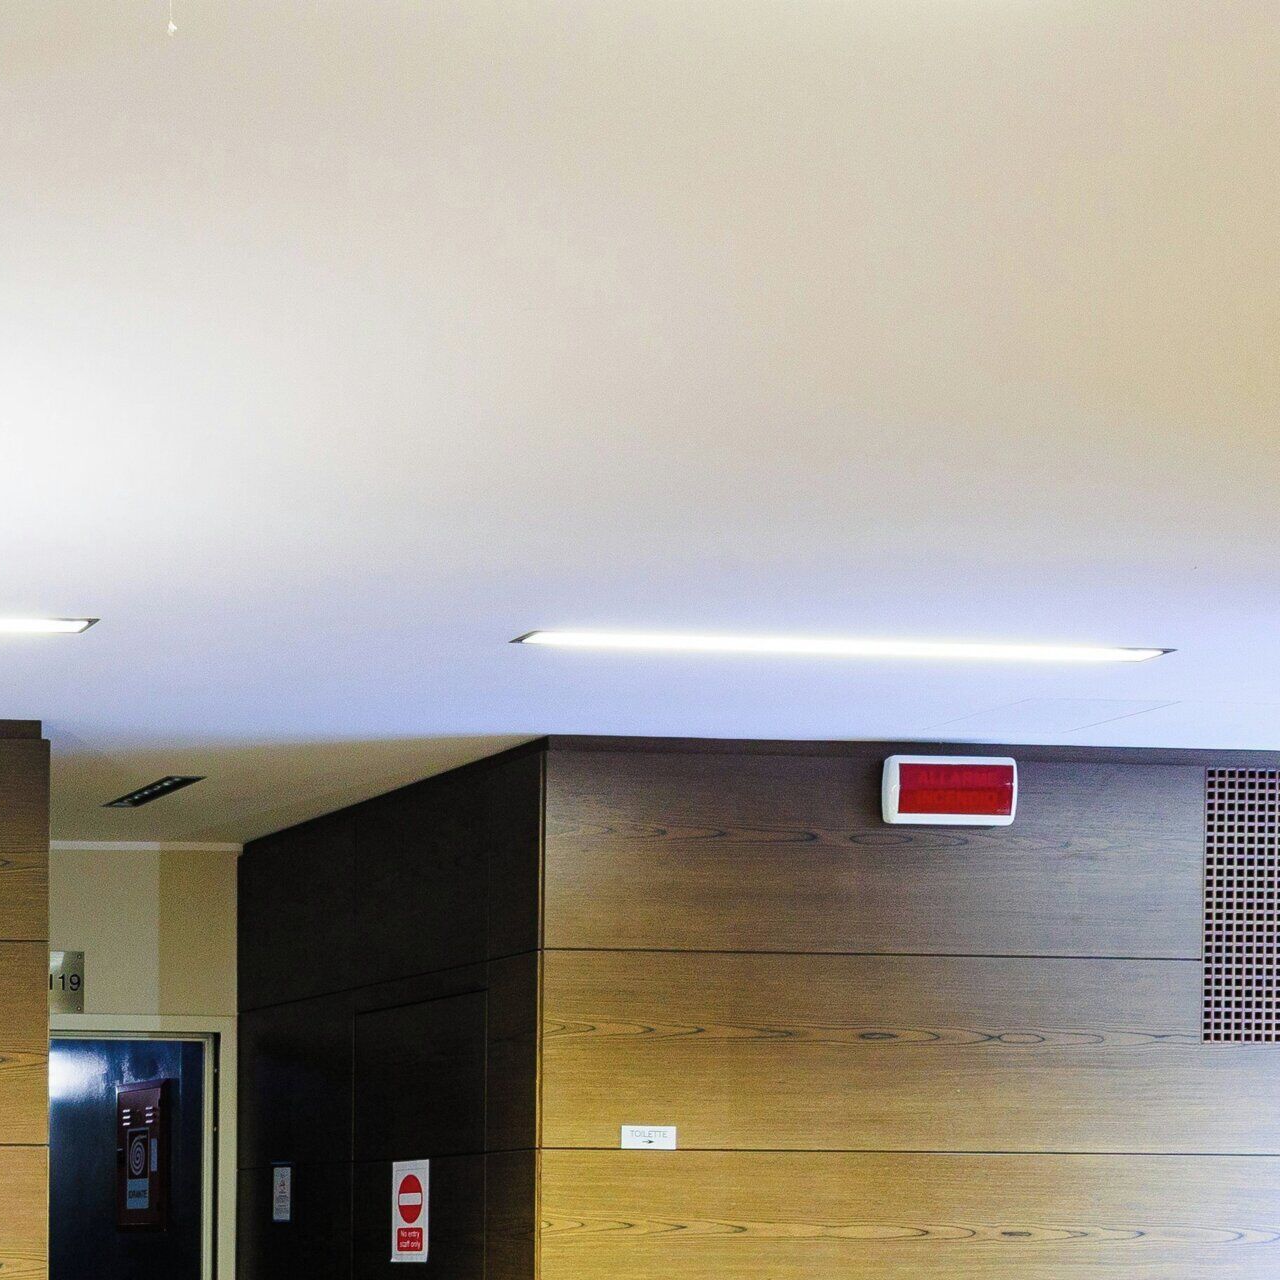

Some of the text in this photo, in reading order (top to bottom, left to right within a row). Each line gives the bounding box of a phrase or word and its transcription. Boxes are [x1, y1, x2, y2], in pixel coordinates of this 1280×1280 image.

[630, 1129, 669, 1138] TOILETTE
[400, 1230, 420, 1239] No entry
[400, 1240, 420, 1250] staff only
